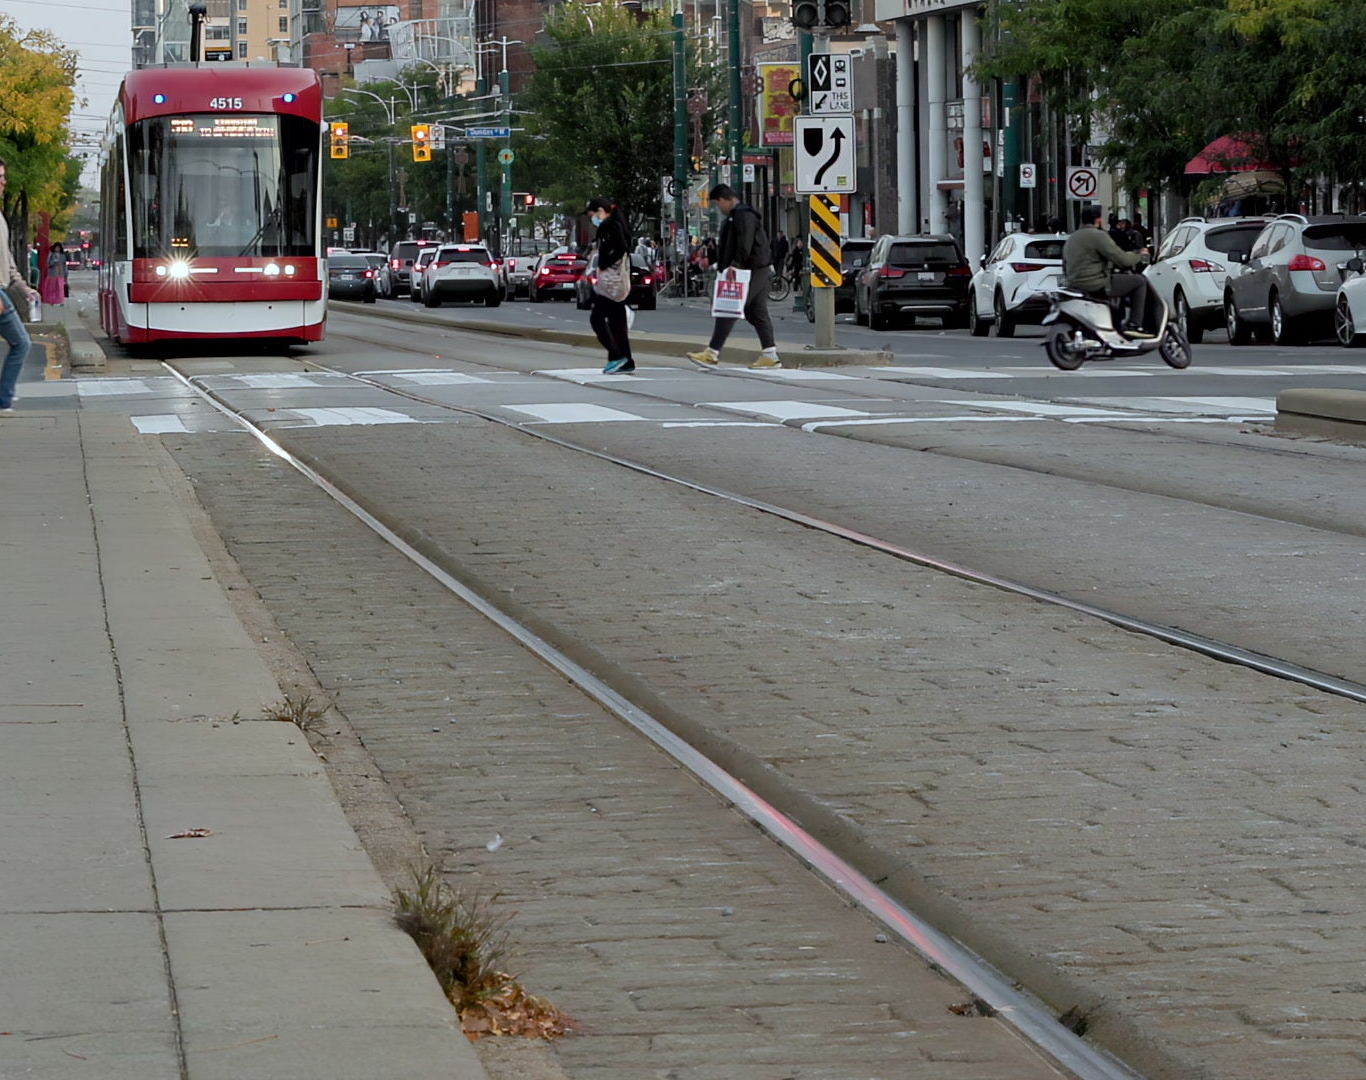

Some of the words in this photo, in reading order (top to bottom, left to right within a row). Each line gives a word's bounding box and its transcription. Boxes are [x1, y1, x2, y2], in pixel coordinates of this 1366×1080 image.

[831, 92, 849, 100] THIS
[209, 97, 243, 109] 4515
[829, 101, 850, 110] LANE
